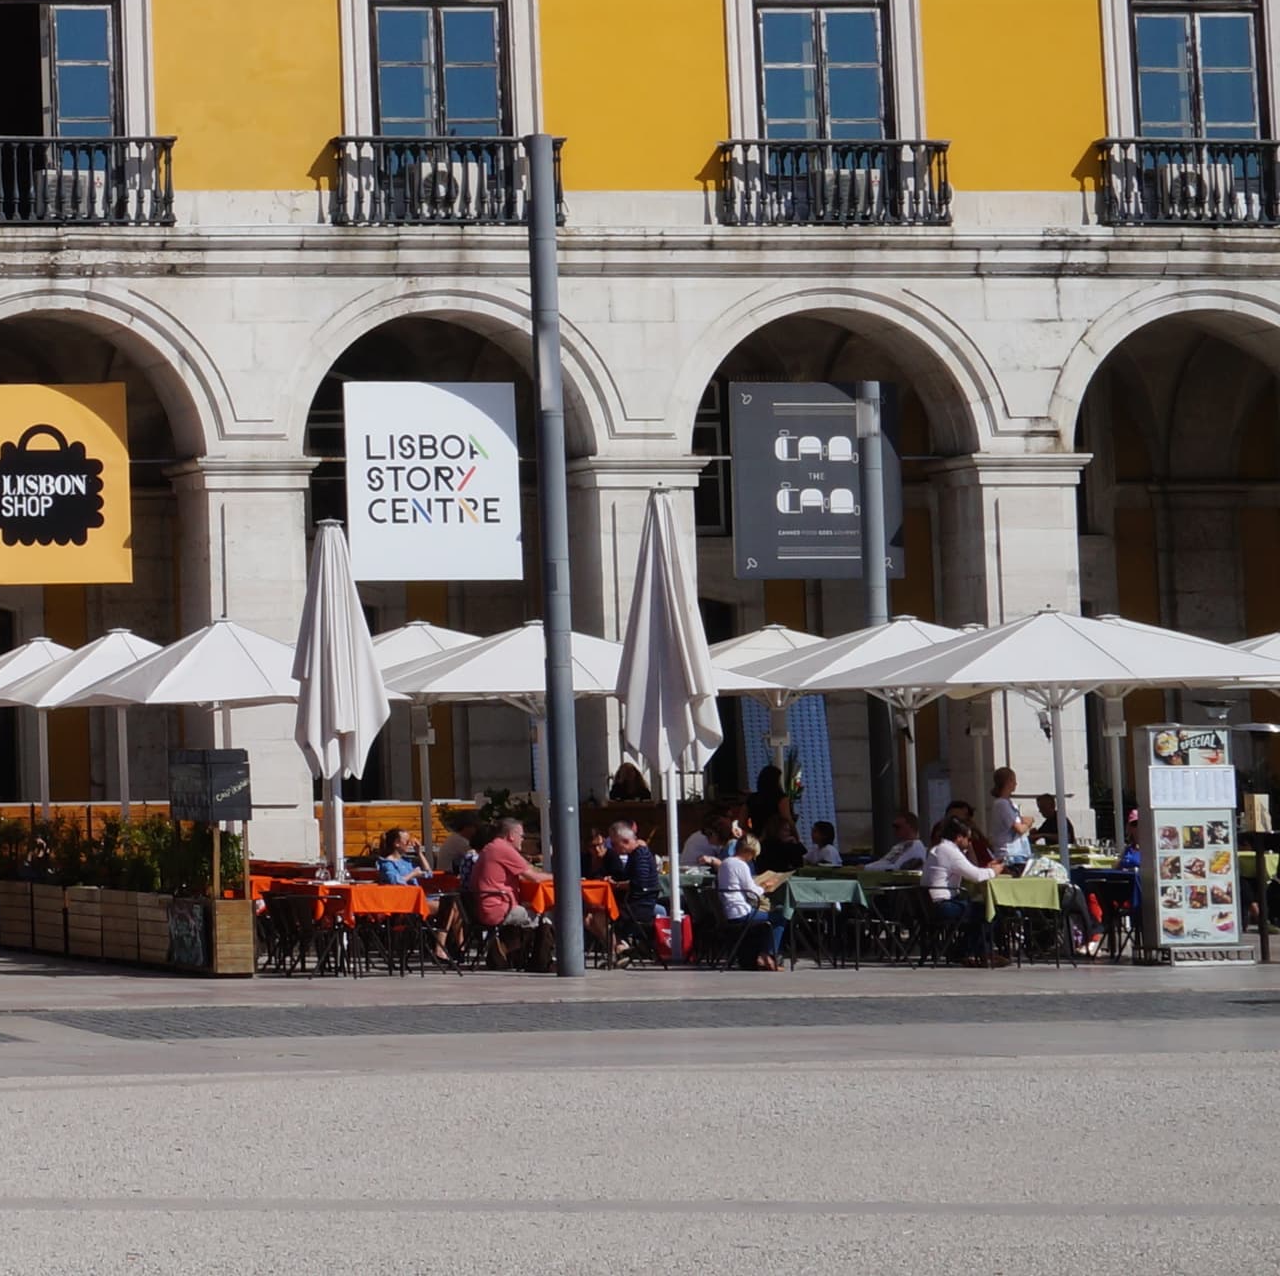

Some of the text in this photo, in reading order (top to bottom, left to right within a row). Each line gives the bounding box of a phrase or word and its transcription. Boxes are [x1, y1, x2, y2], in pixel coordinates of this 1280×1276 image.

[365, 434, 489, 460] LISBOA
[1, 474, 88, 496] LISBON
[367, 466, 476, 492] STORY
[808, 472, 825, 480] THE
[1, 496, 53, 517] SHOP
[368, 498, 501, 524] CENTRE
[1180, 734, 1217, 750] SPECIAL
